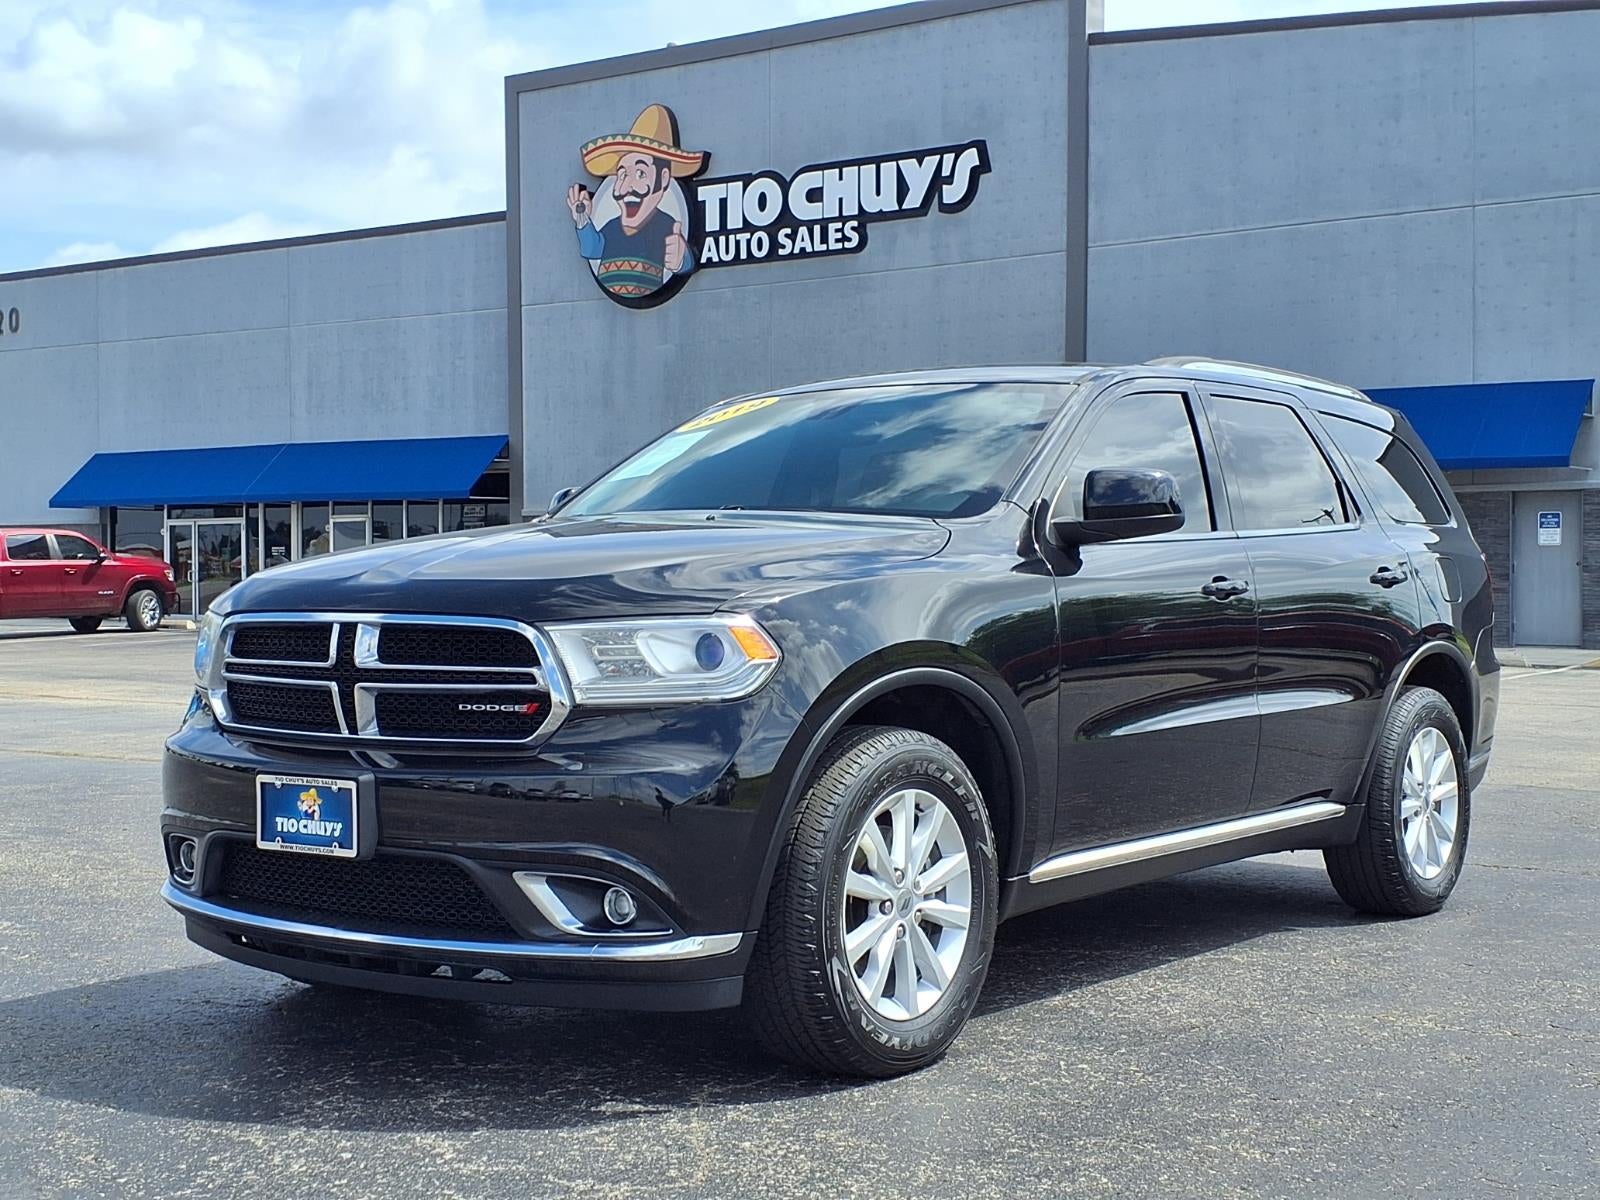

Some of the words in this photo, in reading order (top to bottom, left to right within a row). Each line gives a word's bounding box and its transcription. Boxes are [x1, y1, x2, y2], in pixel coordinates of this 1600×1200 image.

[699, 177, 782, 231] TIO
[789, 147, 981, 220] CHUY'S
[701, 231, 769, 263] AUTO
[777, 222, 860, 256] SALES
[458, 703, 529, 712] DODGE
[276, 817, 298, 832] TIO
[299, 819, 342, 837] CHUY'S
